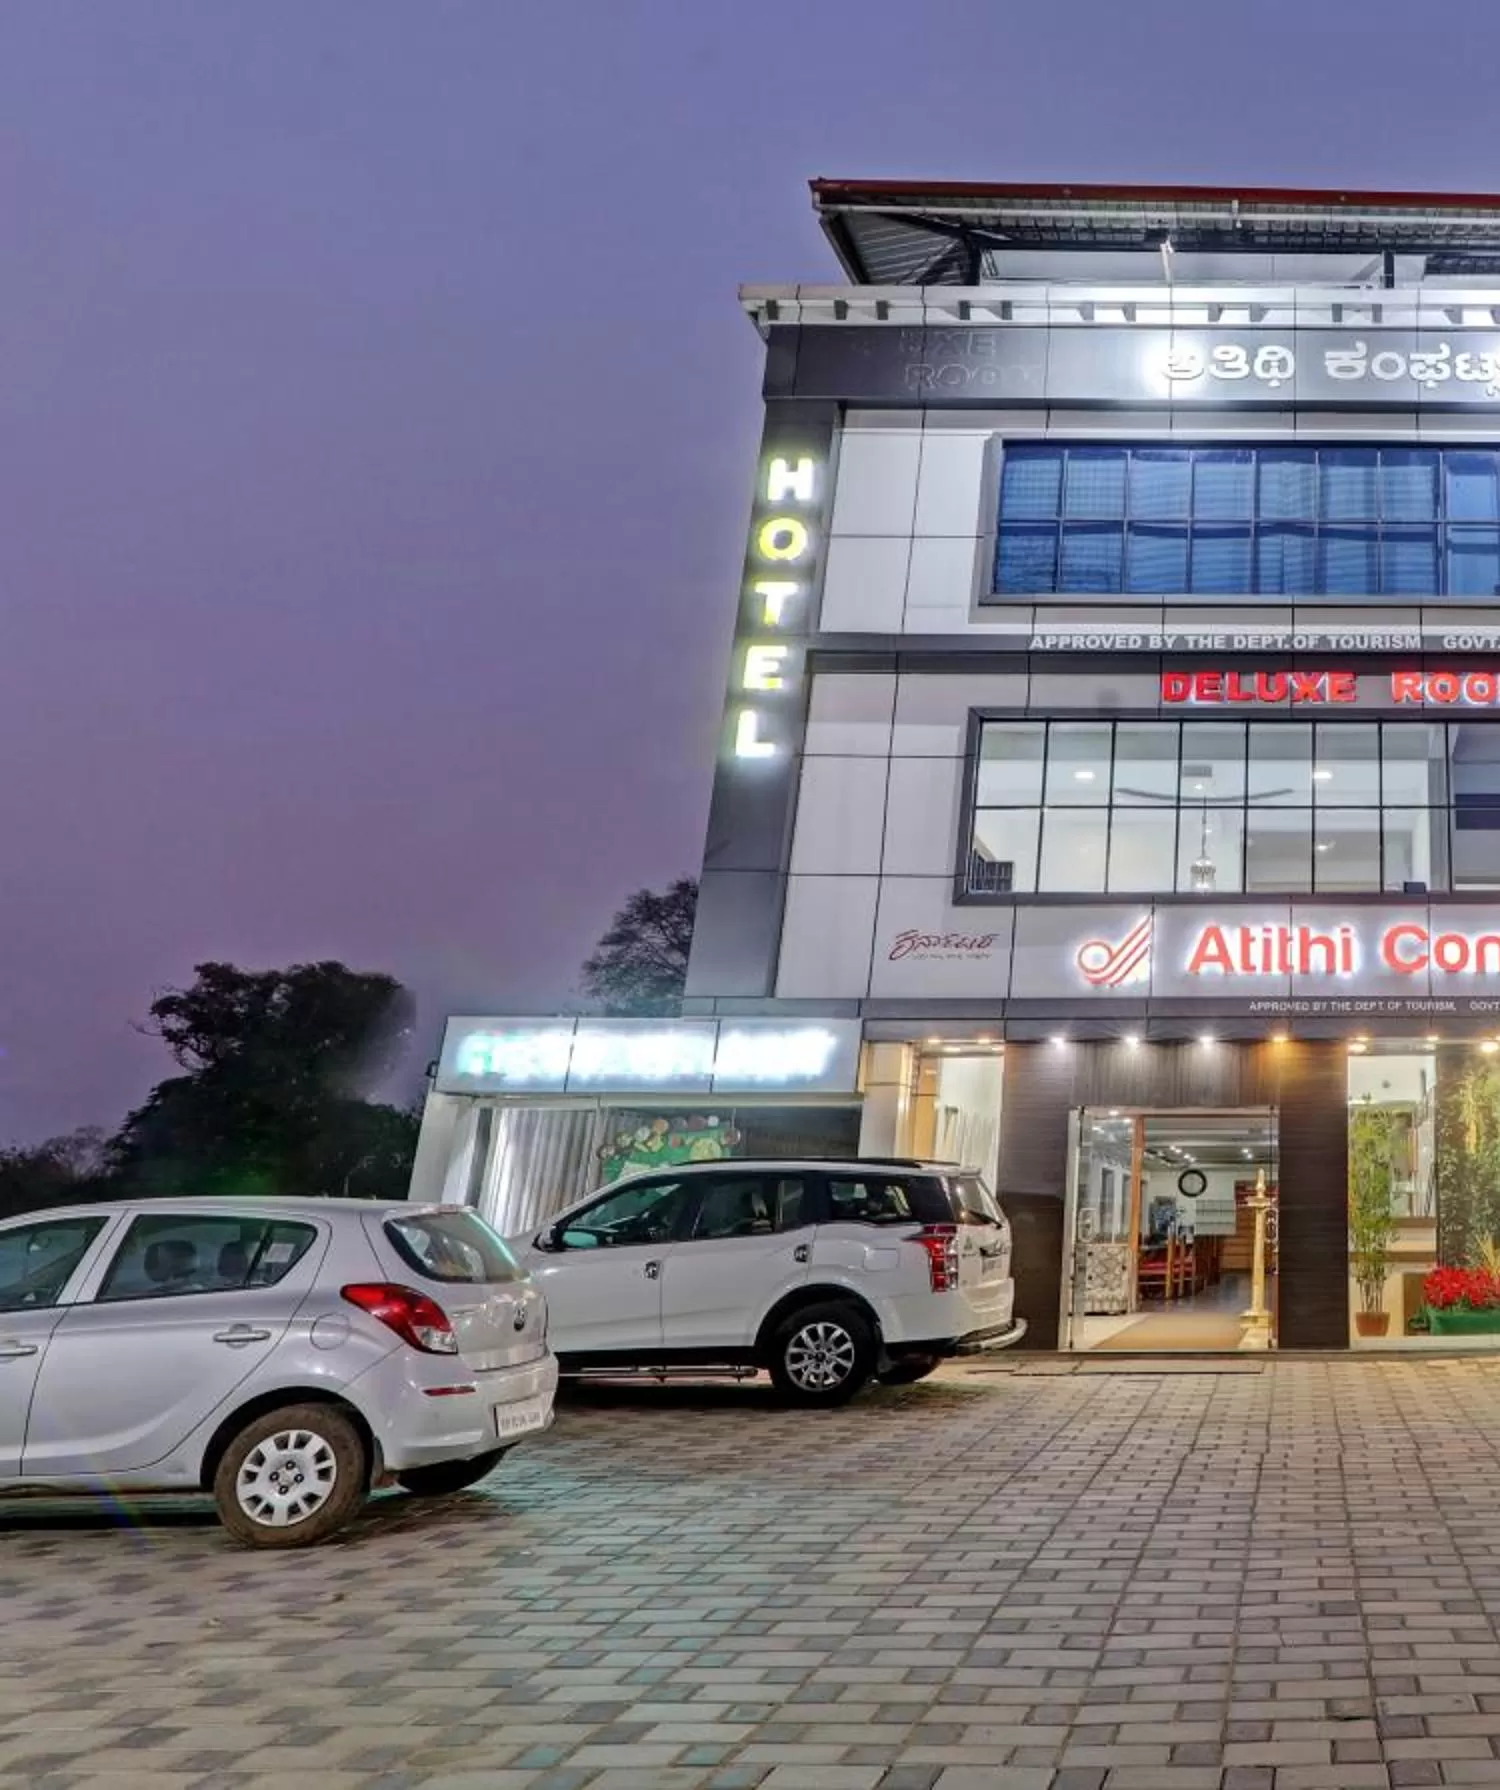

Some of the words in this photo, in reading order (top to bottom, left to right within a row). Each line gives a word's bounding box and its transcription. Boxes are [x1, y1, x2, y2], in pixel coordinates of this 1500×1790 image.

[735, 457, 814, 758] HOTEL
[1029, 634, 1142, 650] APPROVED
[1150, 634, 1182, 650] BY
[1184, 634, 1227, 650] THE
[1295, 634, 1324, 650] OF
[1328, 634, 1421, 650] TOURISM
[1162, 671, 1357, 704] DELUXE
[1187, 924, 1354, 974] Atithi
[1249, 1001, 1309, 1012] APPROVED
[1330, 1001, 1352, 1012] THE
